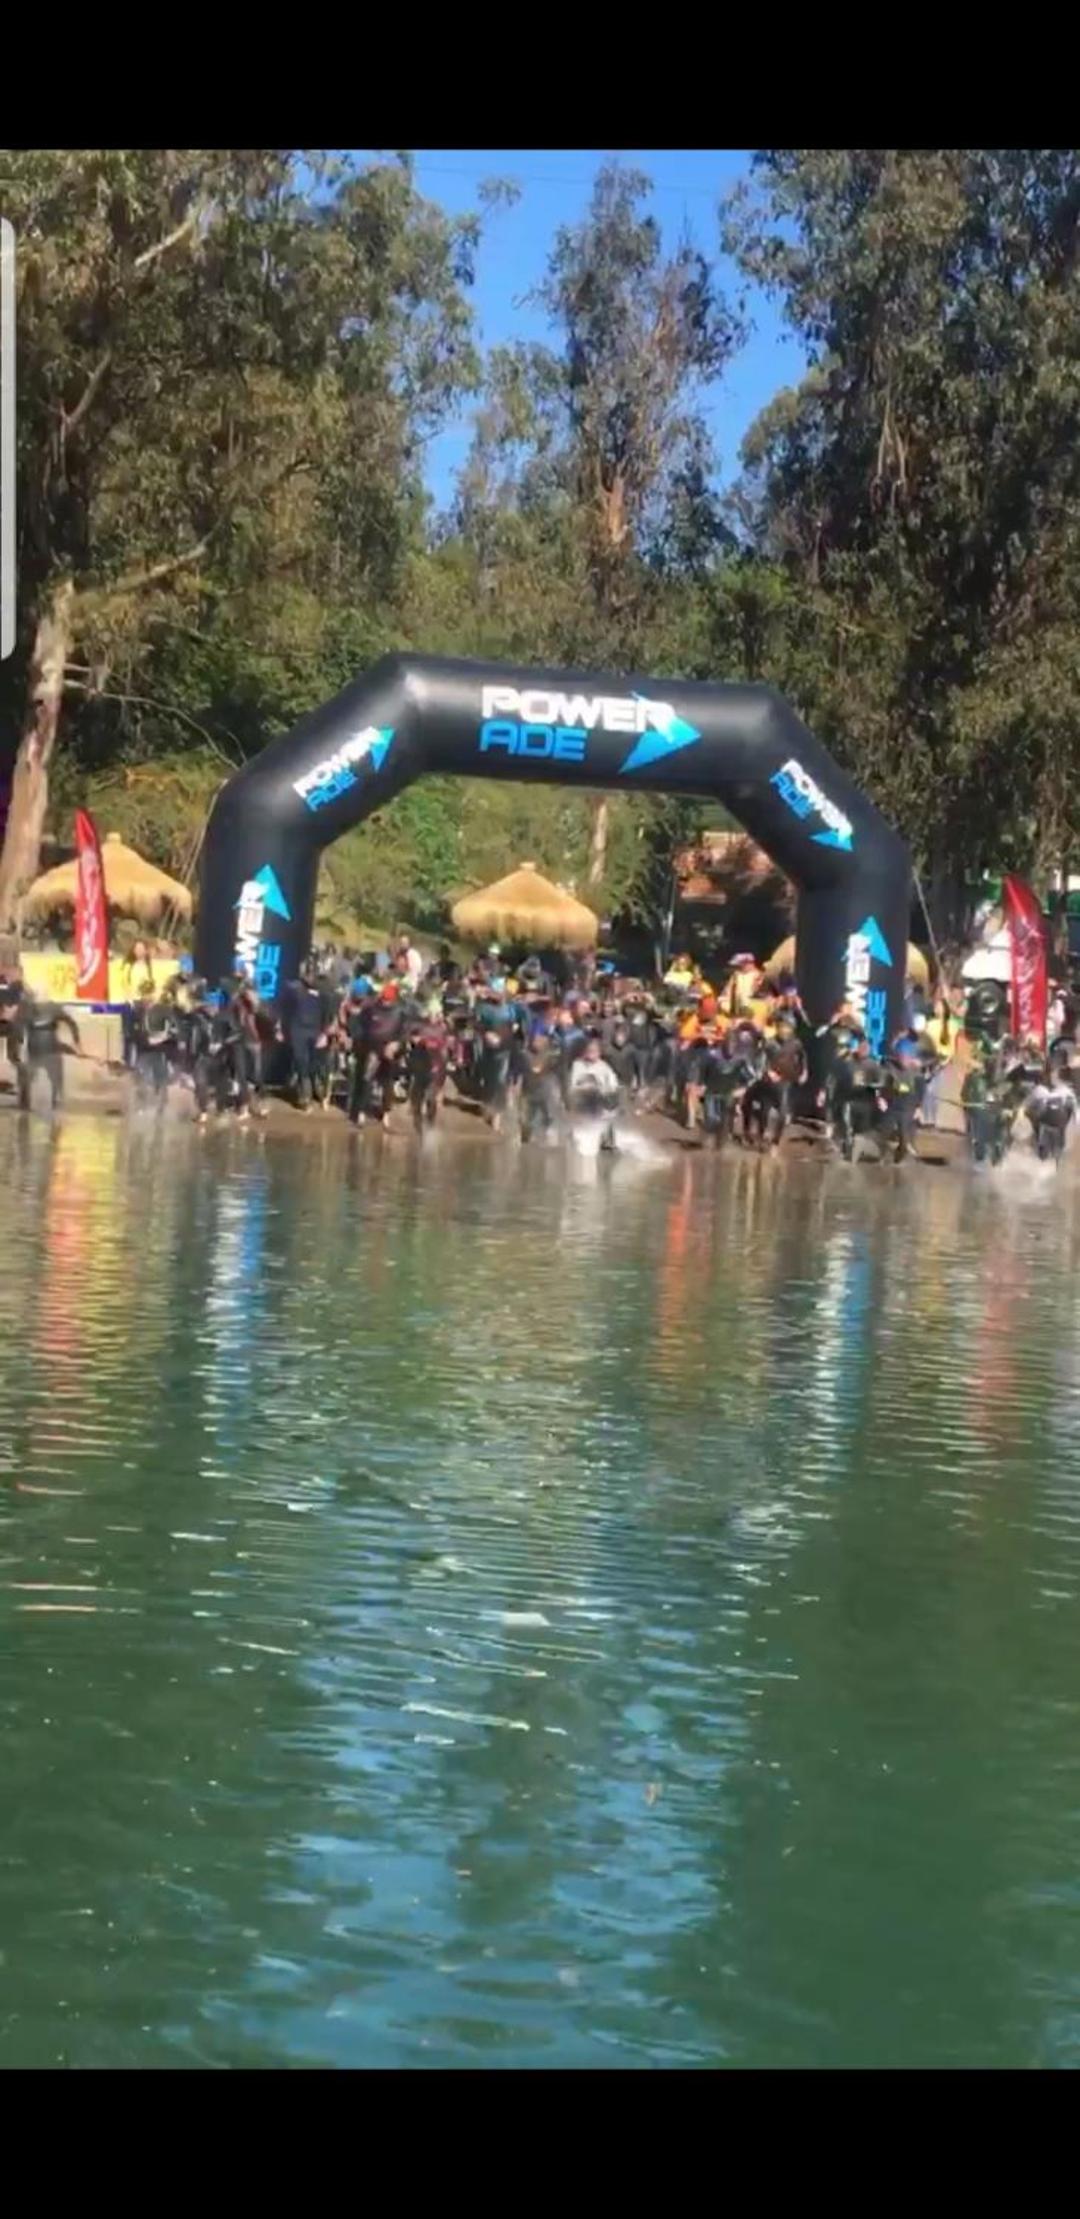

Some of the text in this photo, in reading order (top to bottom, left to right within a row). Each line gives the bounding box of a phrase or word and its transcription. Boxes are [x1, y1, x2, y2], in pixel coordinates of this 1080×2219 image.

[480, 719, 588, 761] ADE
[482, 686, 676, 743] POWER
[293, 726, 386, 798] POWER
[307, 767, 358, 811] ADE
[768, 771, 812, 819] ADE
[781, 758, 853, 841] POWER
[235, 881, 269, 979] WER
[845, 933, 871, 1034] WER
